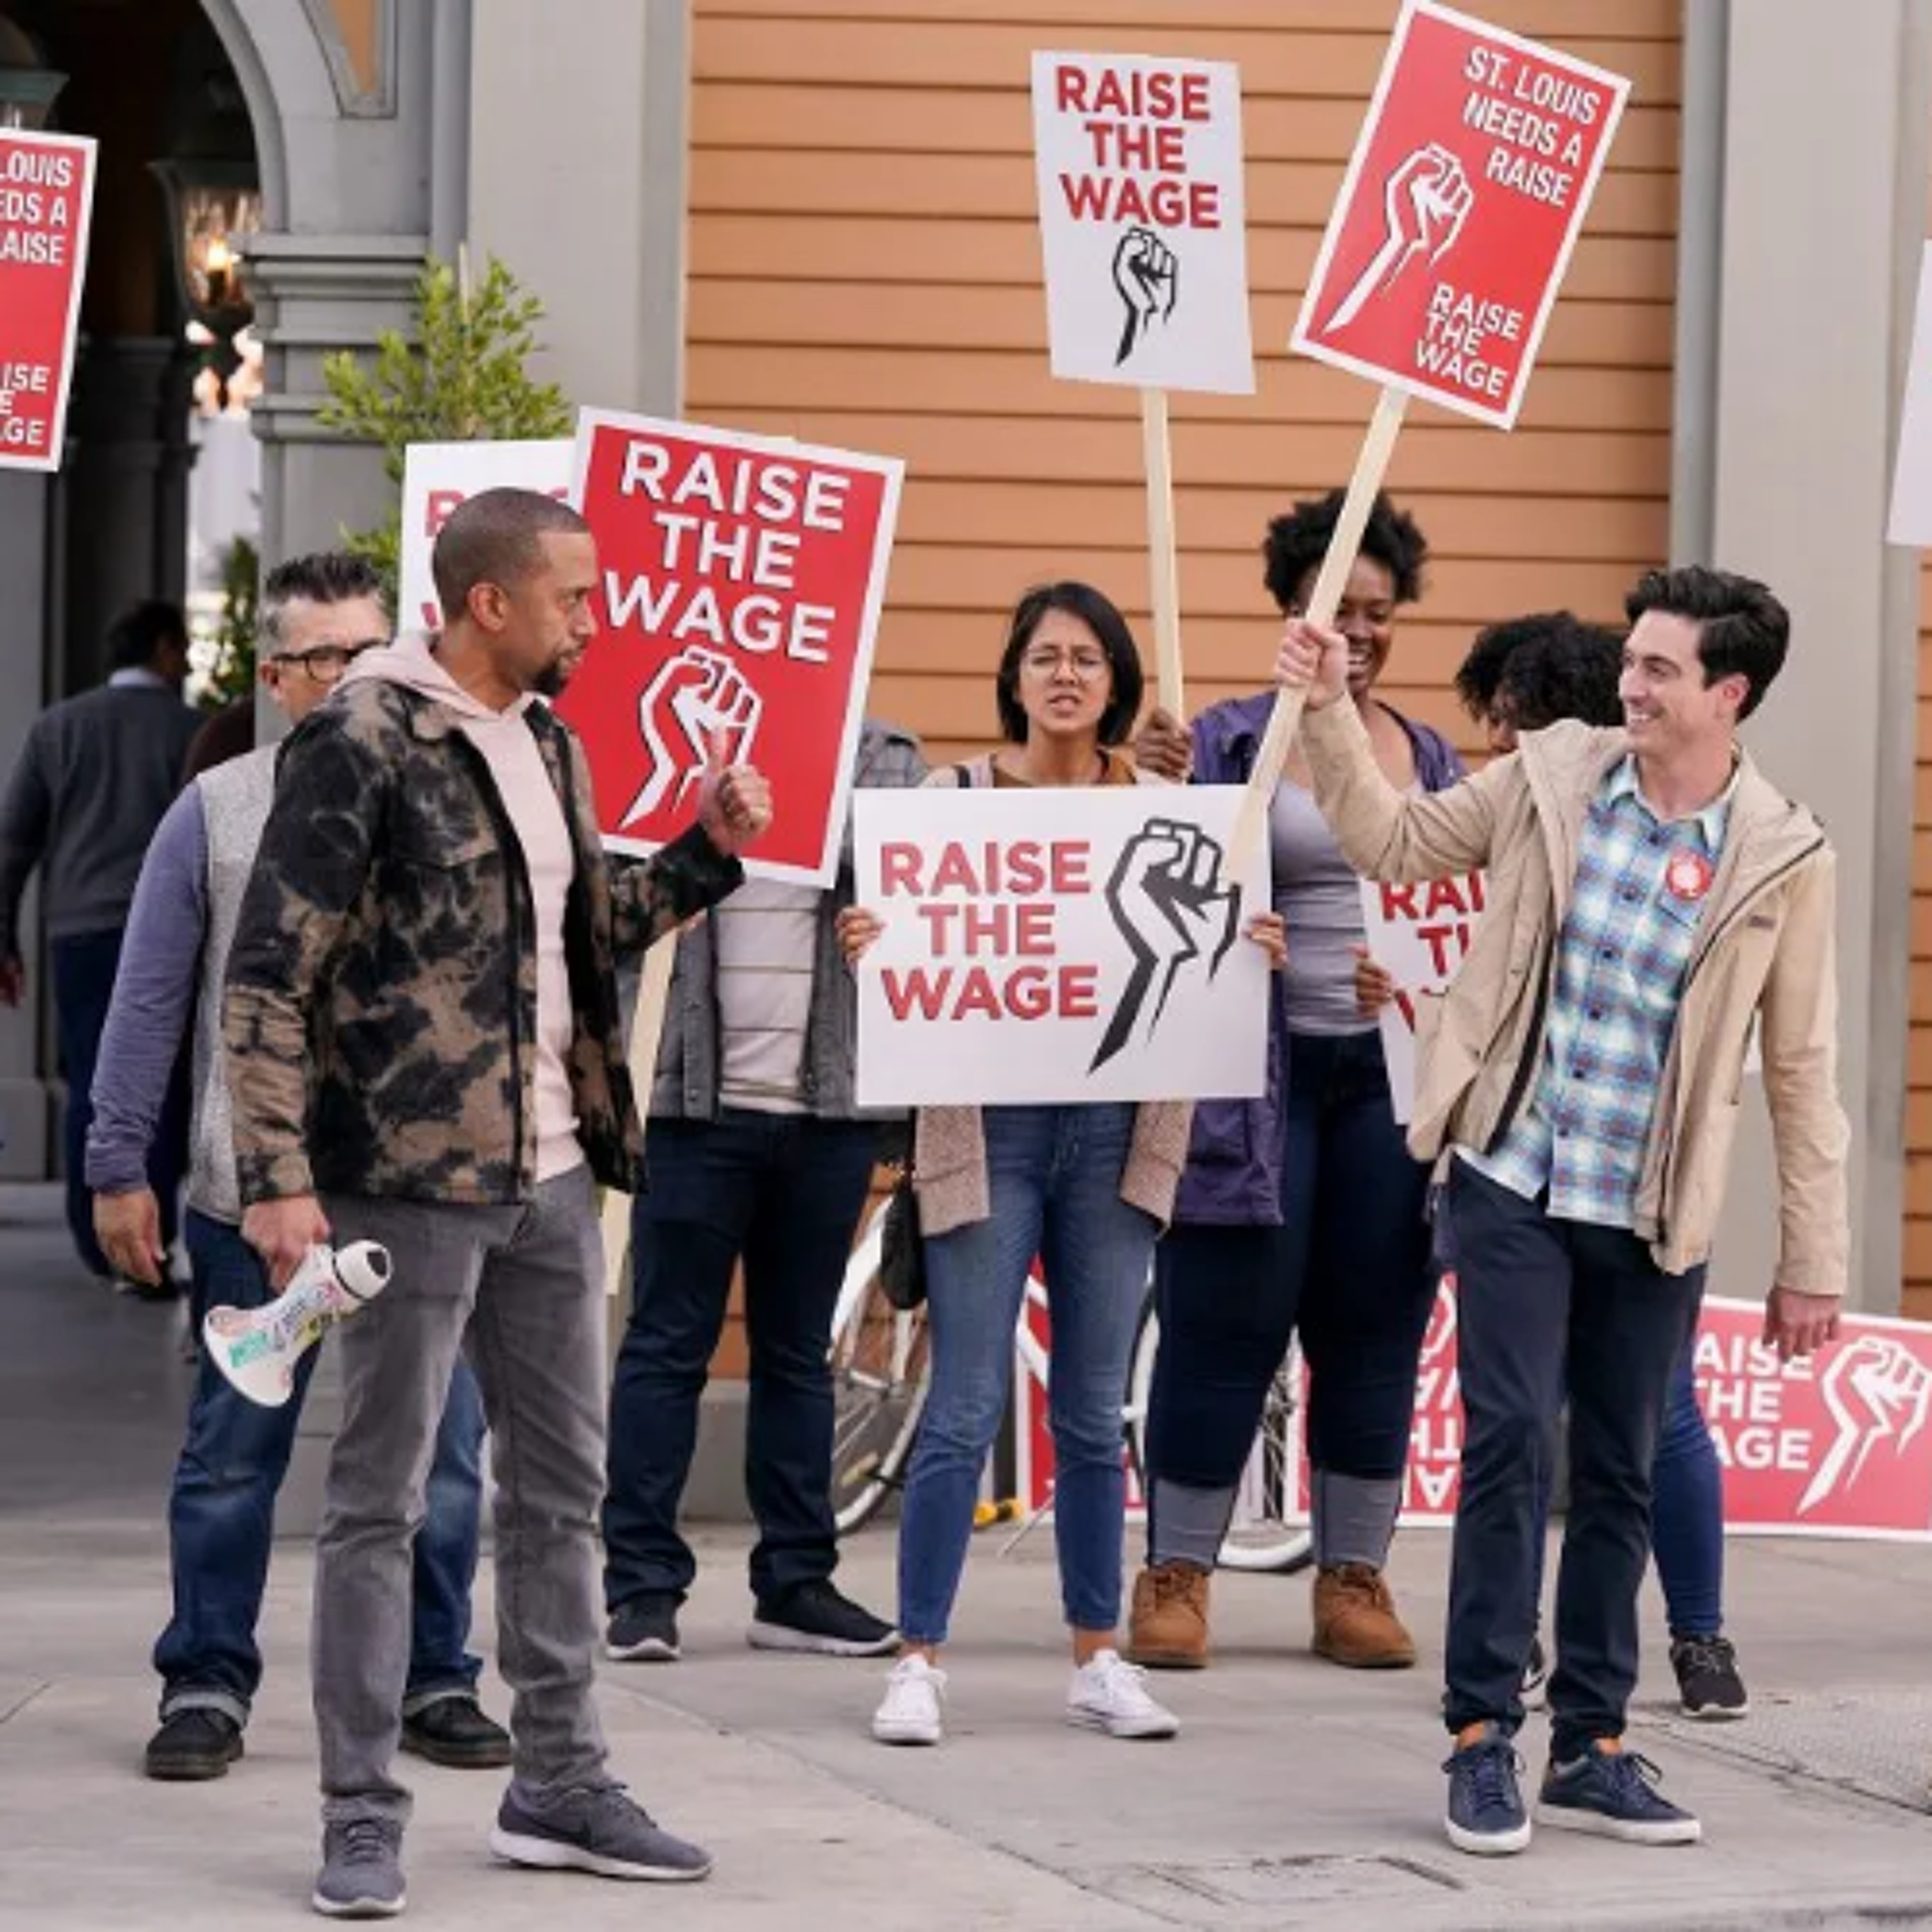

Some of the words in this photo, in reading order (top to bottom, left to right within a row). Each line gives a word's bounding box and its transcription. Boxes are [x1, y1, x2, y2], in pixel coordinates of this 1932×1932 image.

[1056, 66, 1211, 121] RAISE
[1464, 46, 1510, 89] ST.
[1514, 65, 1600, 125] LOUIS
[1084, 122, 1186, 173] THE
[1463, 91, 1558, 156] NEEDS
[1560, 132, 1582, 167] A
[0, 149, 73, 187] OUIS
[1486, 146, 1573, 209] RAISE
[49, 196, 68, 227] A
[1059, 173, 1220, 229] WAGE
[0, 229, 66, 268] AISE
[1421, 312, 1485, 356] THE
[1430, 282, 1523, 342] RAISE
[1417, 339, 1509, 398] WAGE
[620, 440, 851, 531] RAISE
[654, 511, 801, 589] THE
[603, 571, 837, 663] WAGE
[880, 841, 1091, 896] RAISE
[1379, 865, 1484, 921] RAI
[918, 903, 1056, 956] THE
[880, 966, 1099, 1021] WAGE
